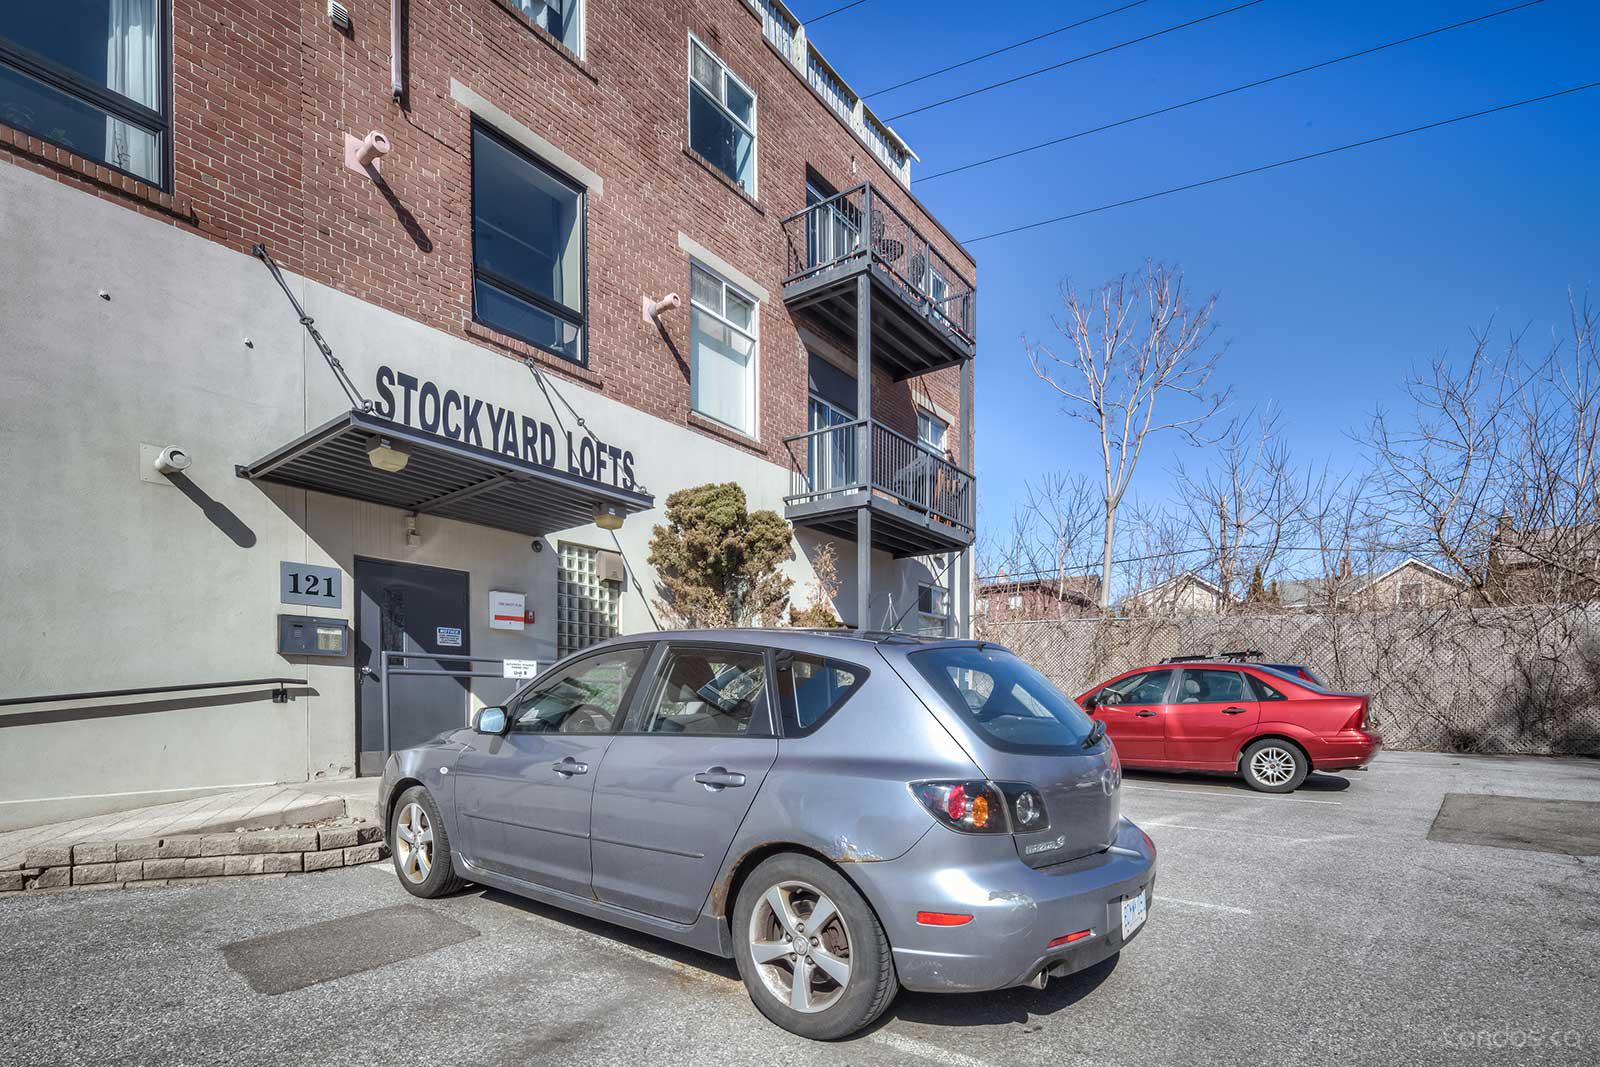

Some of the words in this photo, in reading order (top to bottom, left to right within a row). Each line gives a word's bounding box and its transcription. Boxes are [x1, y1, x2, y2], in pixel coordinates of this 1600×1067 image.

[376, 365, 556, 469] STOCKYARD
[567, 430, 635, 491] LOFTS
[288, 573, 336, 598] 121
